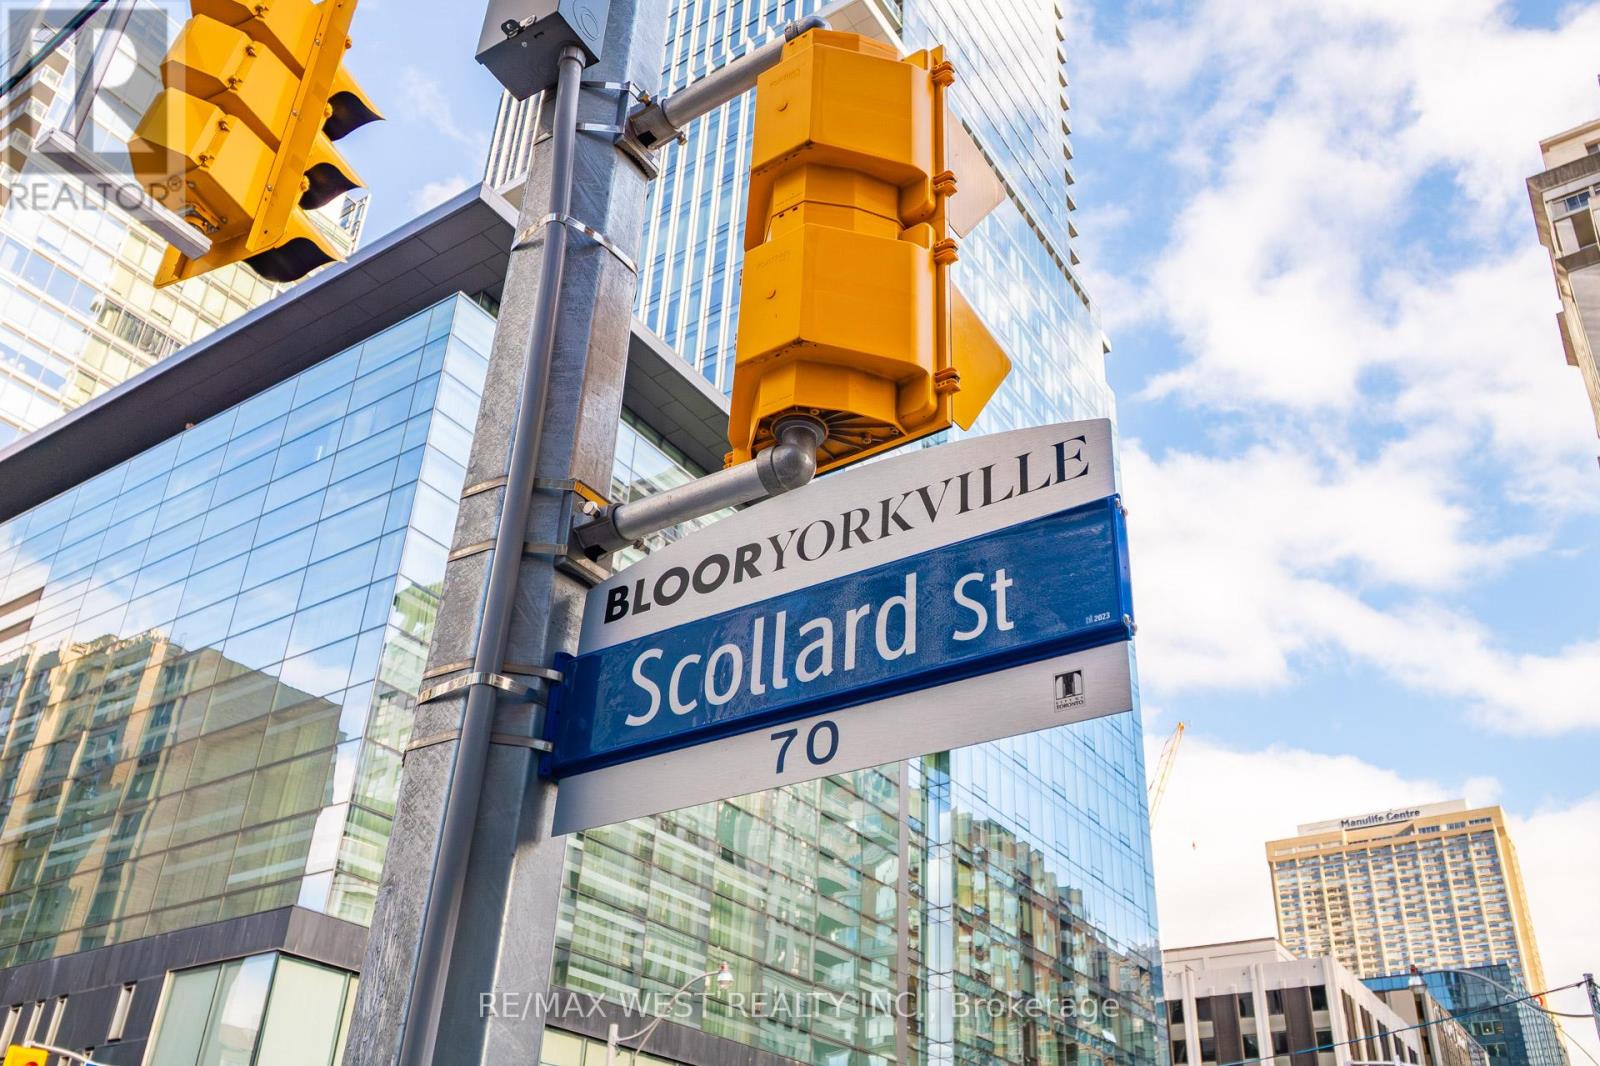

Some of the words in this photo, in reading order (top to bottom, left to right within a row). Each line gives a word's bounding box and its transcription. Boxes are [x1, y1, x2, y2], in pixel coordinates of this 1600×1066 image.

[1093, 611, 1111, 622] 2023
[624, 572, 918, 728] Scollard
[952, 568, 1016, 642] St
[769, 720, 840, 775] 70
[1340, 814, 1384, 828] Manulife
[1386, 809, 1420, 821] Centre
